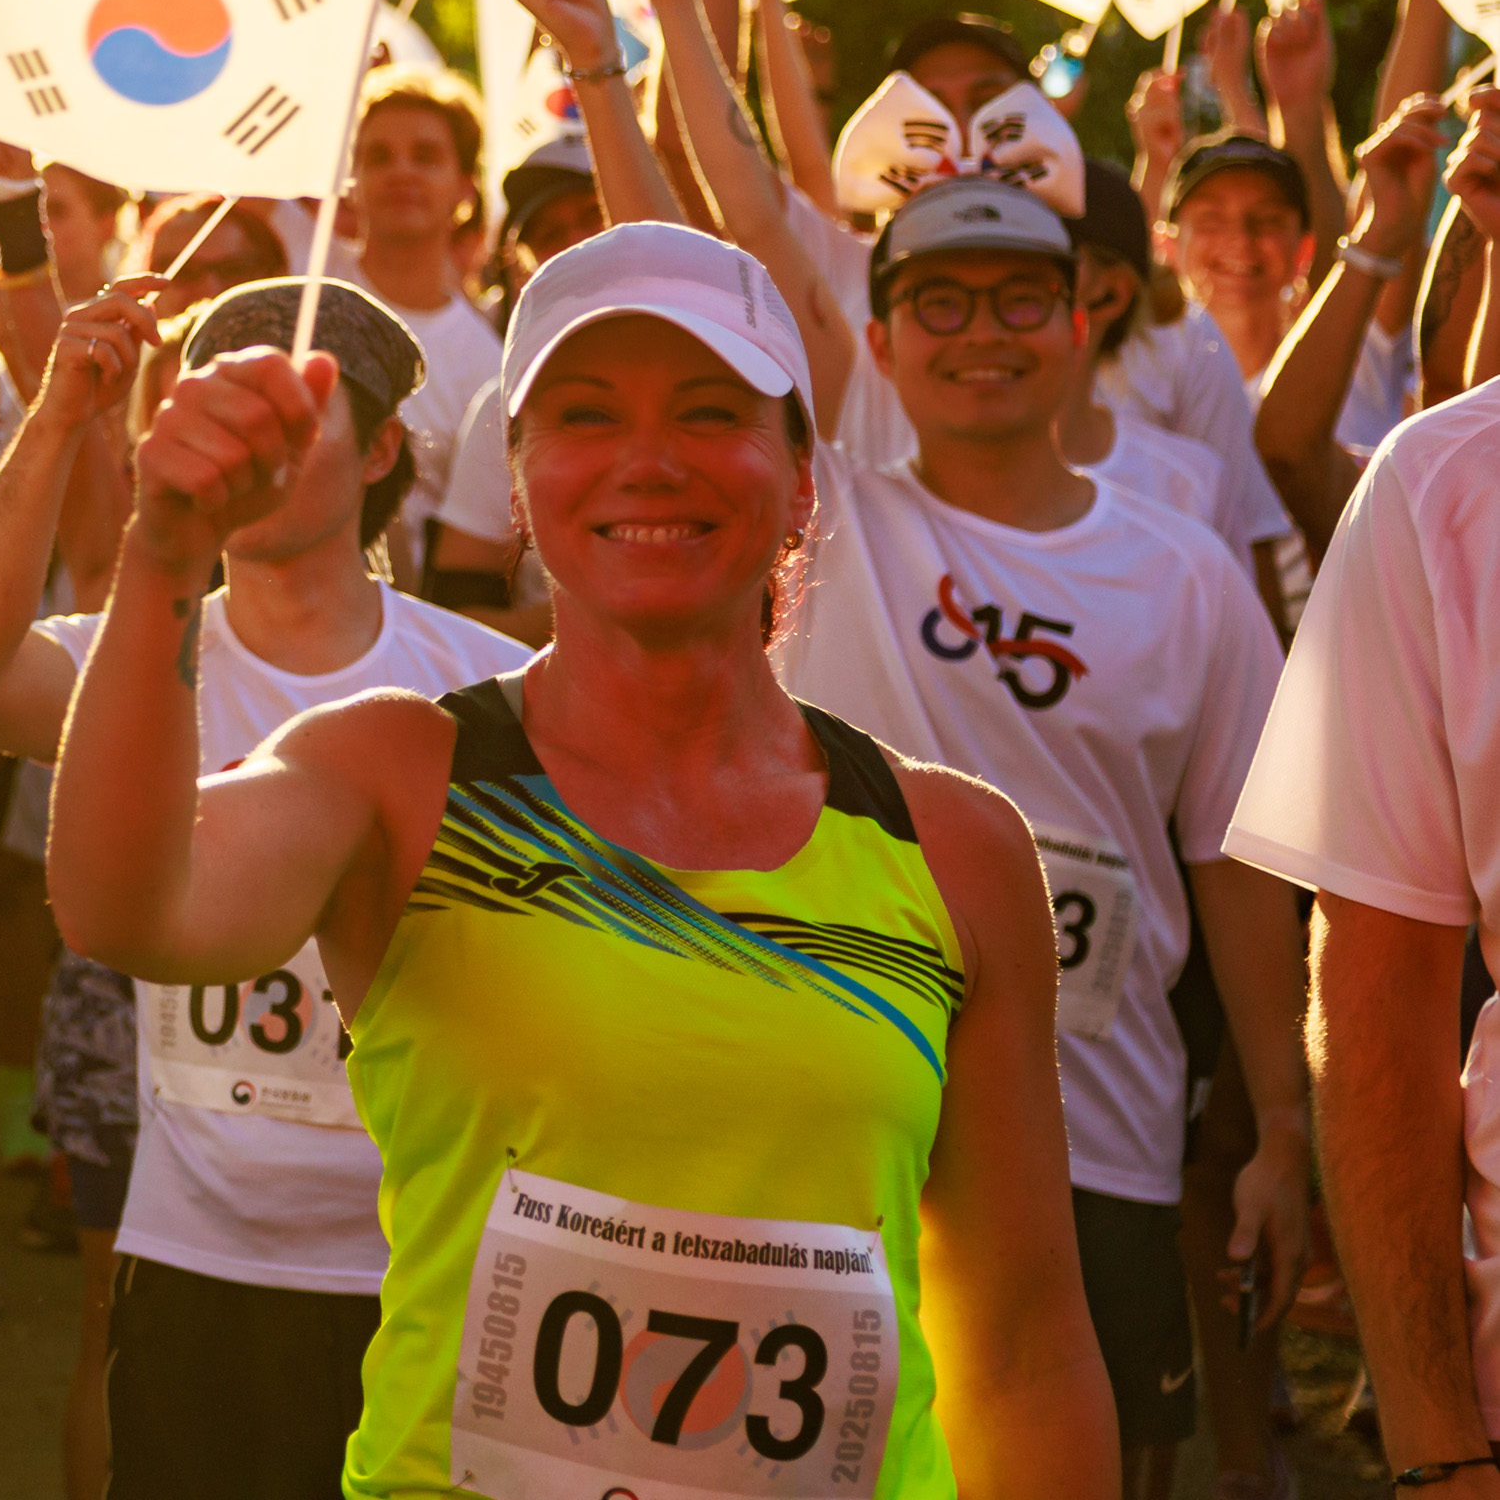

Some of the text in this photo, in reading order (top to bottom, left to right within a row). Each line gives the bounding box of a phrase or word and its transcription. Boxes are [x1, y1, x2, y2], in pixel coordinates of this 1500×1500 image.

[189, 968, 356, 1062] 03
[513, 1192, 875, 1276] Fuss Koreáért a felszabadulás napján!
[472, 1252, 528, 1421] 19450815
[533, 1290, 828, 1462] 073
[831, 1308, 882, 1485] 20250815
